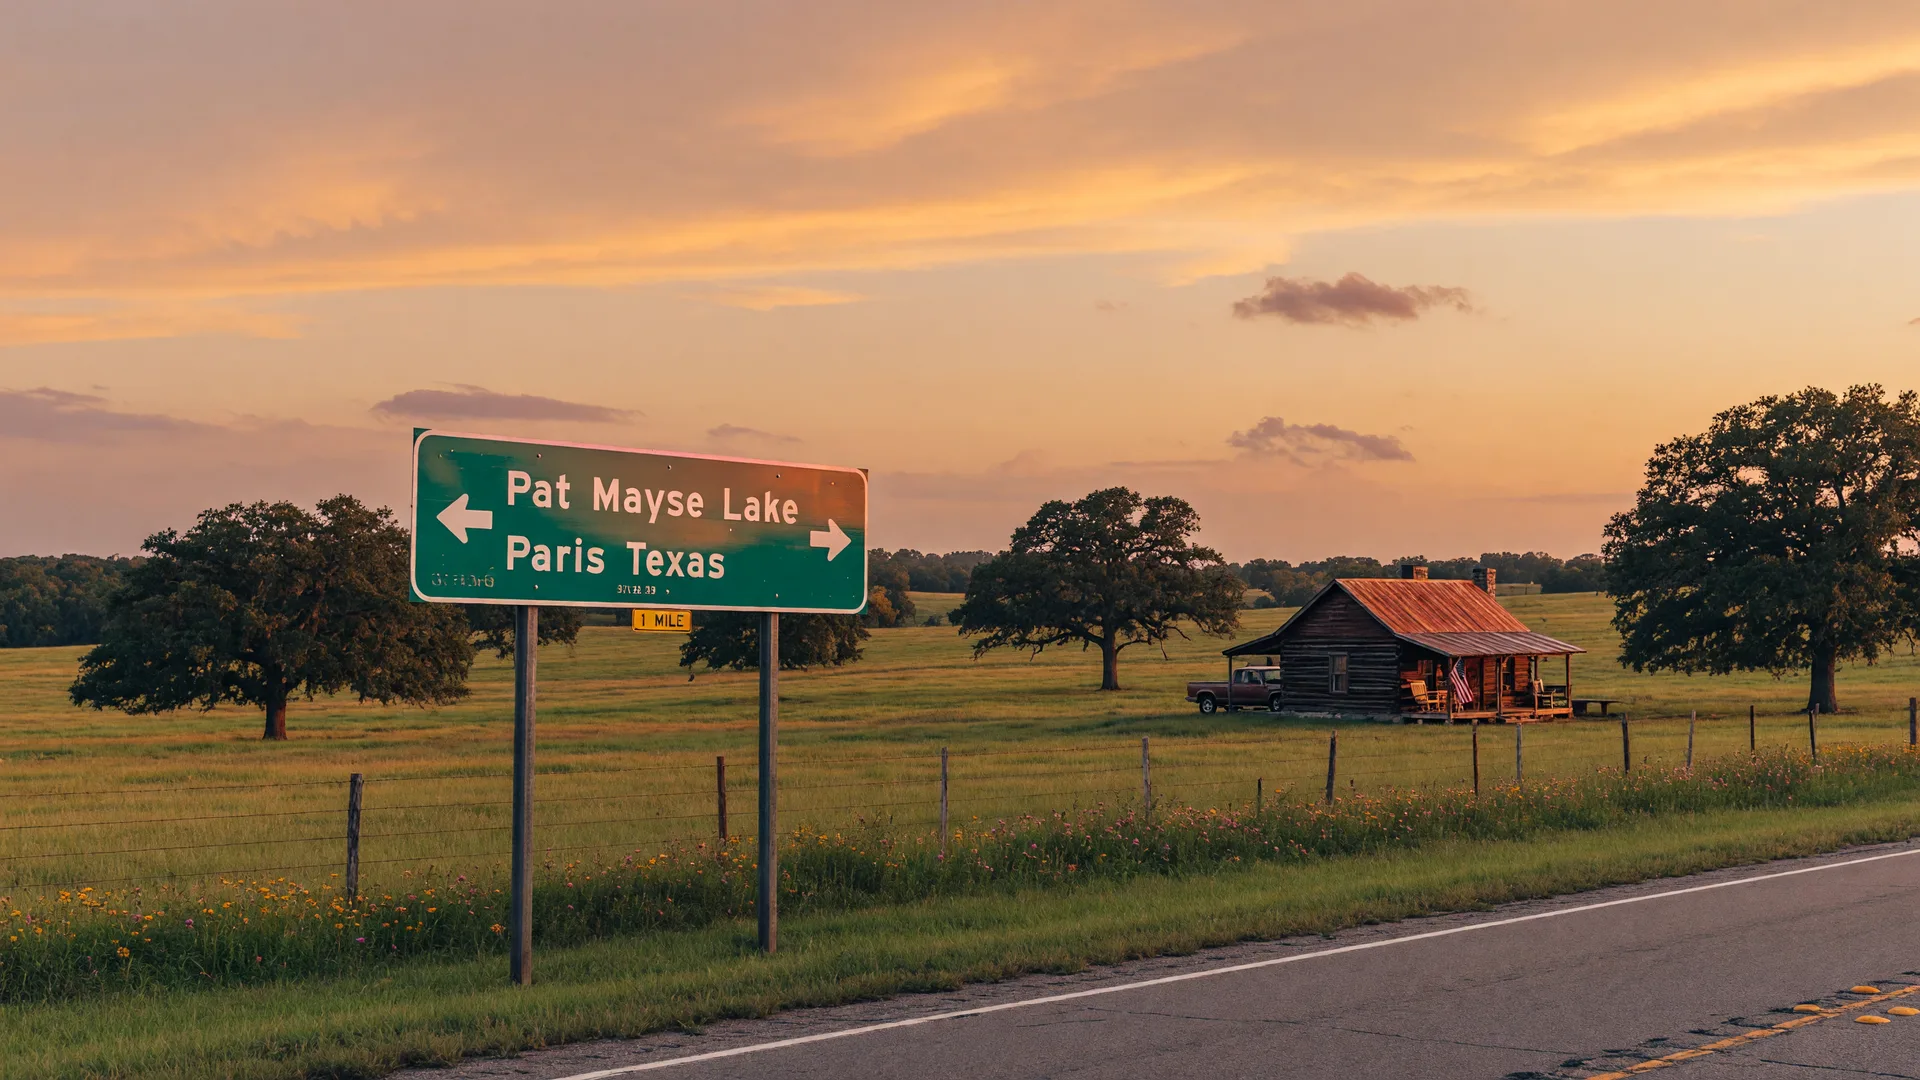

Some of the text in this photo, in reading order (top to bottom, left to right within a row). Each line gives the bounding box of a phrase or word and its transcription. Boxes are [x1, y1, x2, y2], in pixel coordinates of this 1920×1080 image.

[507, 470, 798, 525] Pat Mayse Lake
[507, 535, 725, 579] Paris Texas
[641, 613, 684, 627] 1 MILE
